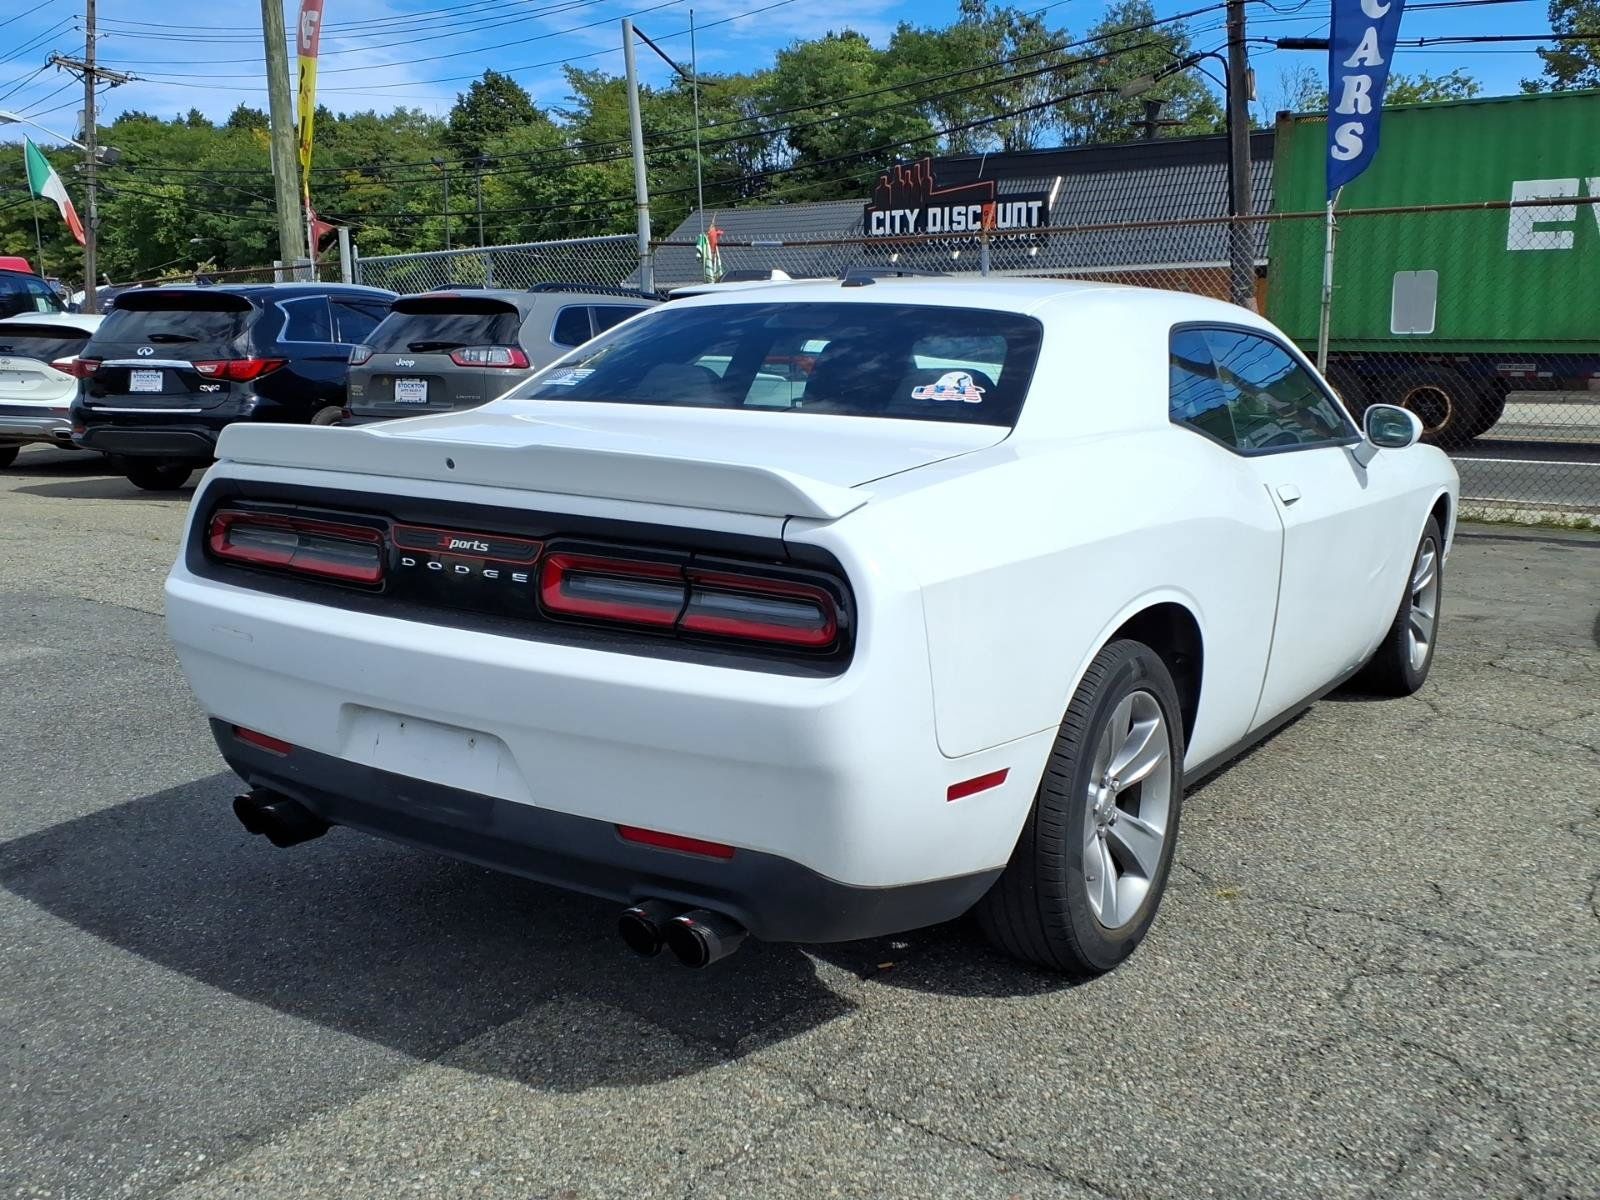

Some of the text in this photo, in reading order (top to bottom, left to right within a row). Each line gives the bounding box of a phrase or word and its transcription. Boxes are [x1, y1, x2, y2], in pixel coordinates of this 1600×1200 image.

[871, 208, 920, 236] CITY
[395, 358, 415, 368] Jeep
[401, 557, 528, 583] DODGE
